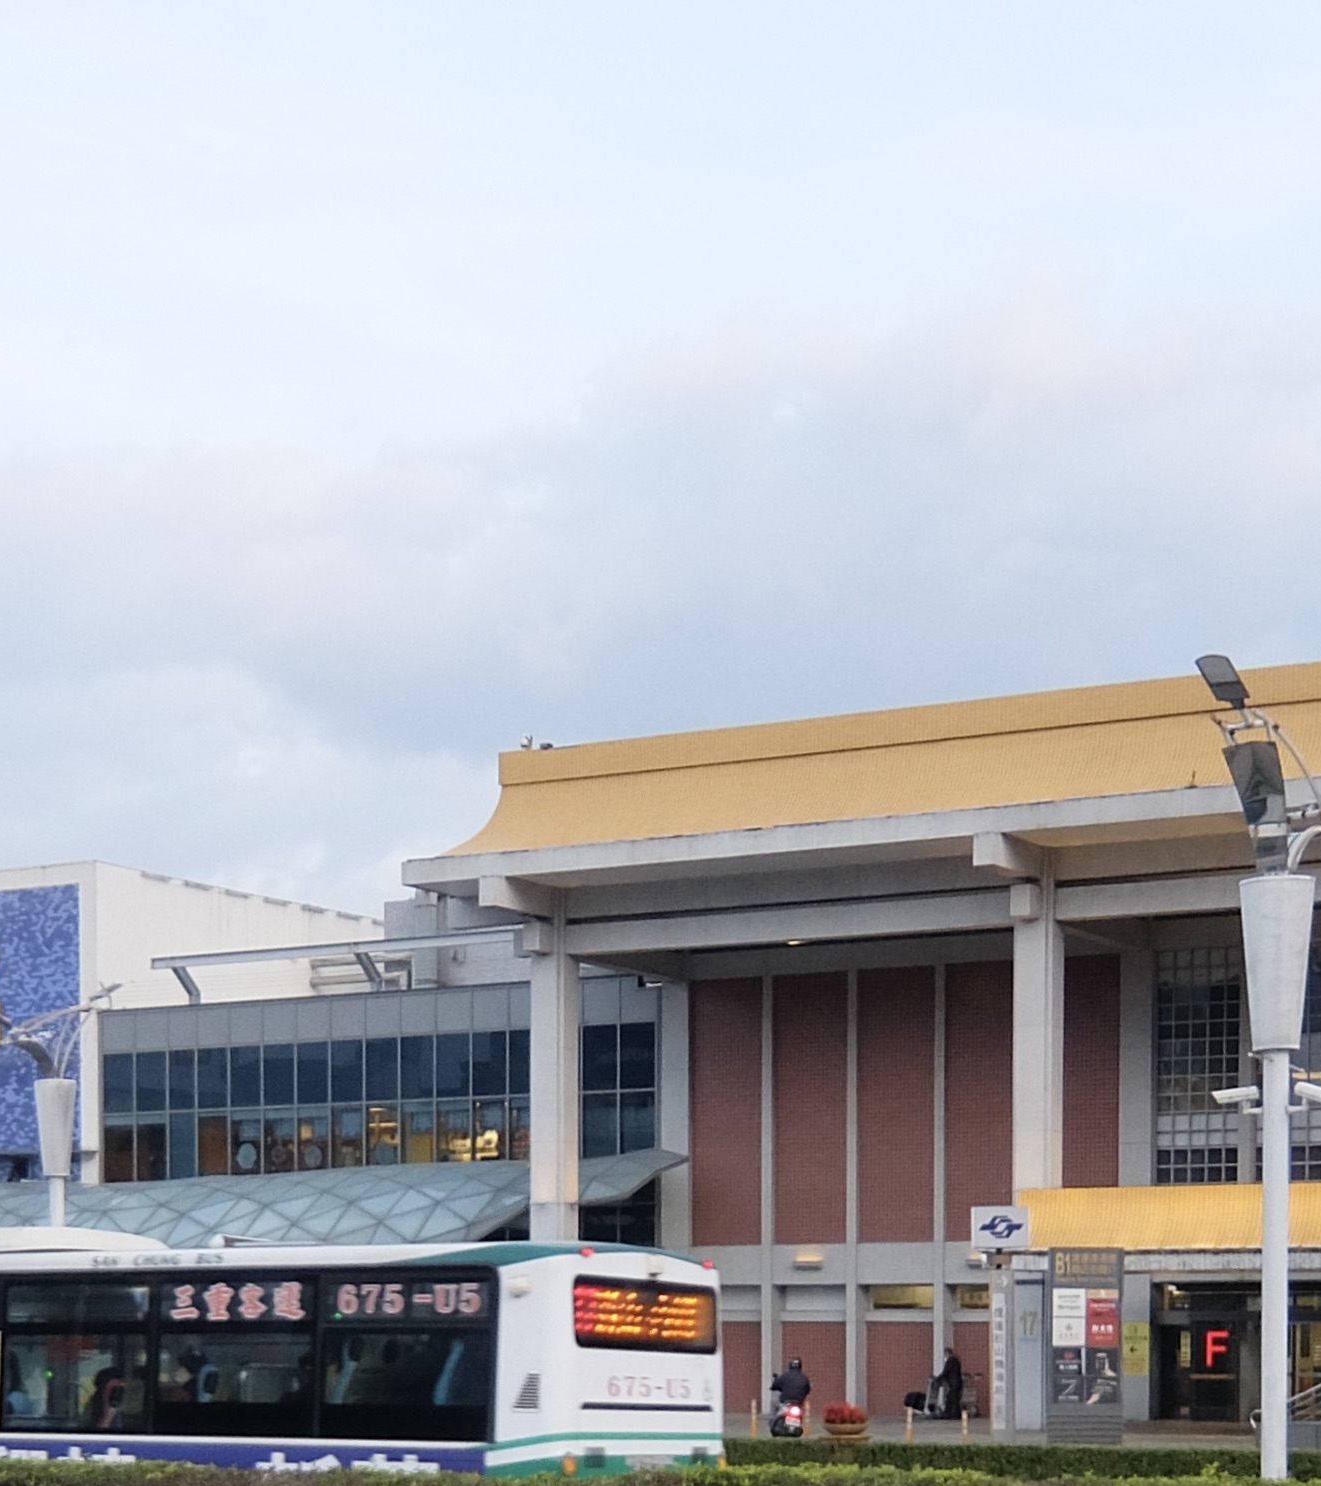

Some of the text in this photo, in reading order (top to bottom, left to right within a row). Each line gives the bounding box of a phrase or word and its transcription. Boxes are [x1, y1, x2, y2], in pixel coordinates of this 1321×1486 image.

[195, 1253, 225, 1265] BUS
[169, 1281, 307, 1321] 三重客運
[336, 1283, 481, 1315] 675-U5
[1205, 1329, 1230, 1368] F
[606, 1375, 692, 1399] 675-U5
